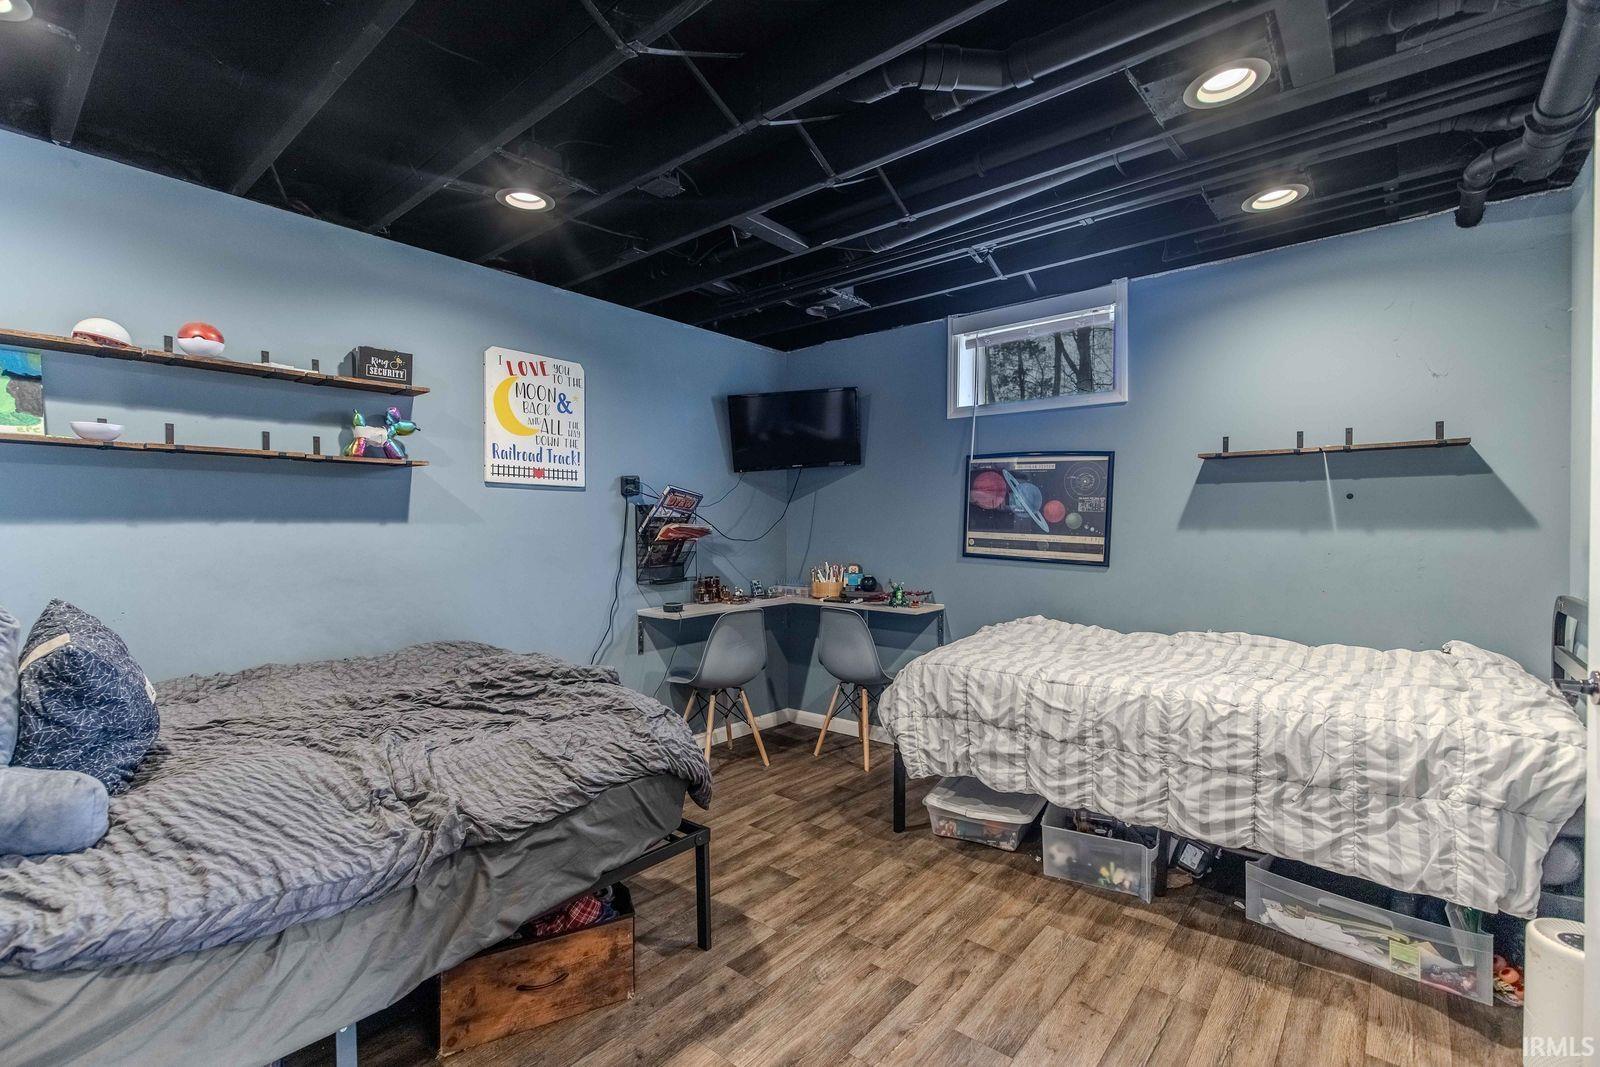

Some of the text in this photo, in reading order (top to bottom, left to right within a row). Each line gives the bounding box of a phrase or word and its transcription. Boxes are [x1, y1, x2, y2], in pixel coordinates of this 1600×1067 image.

[371, 356, 388, 368] Ring
[498, 354, 570, 377] I LOVE YOU
[370, 366, 405, 378] SECURITY
[552, 373, 583, 389] TO THE
[515, 382, 574, 414] MOON &
[522, 400, 551, 416] BACK
[540, 417, 563, 437] ALL
[567, 429, 581, 439] WAY
[535, 434, 579, 450] DOWN THE
[492, 442, 581, 467] Railroad Track!
